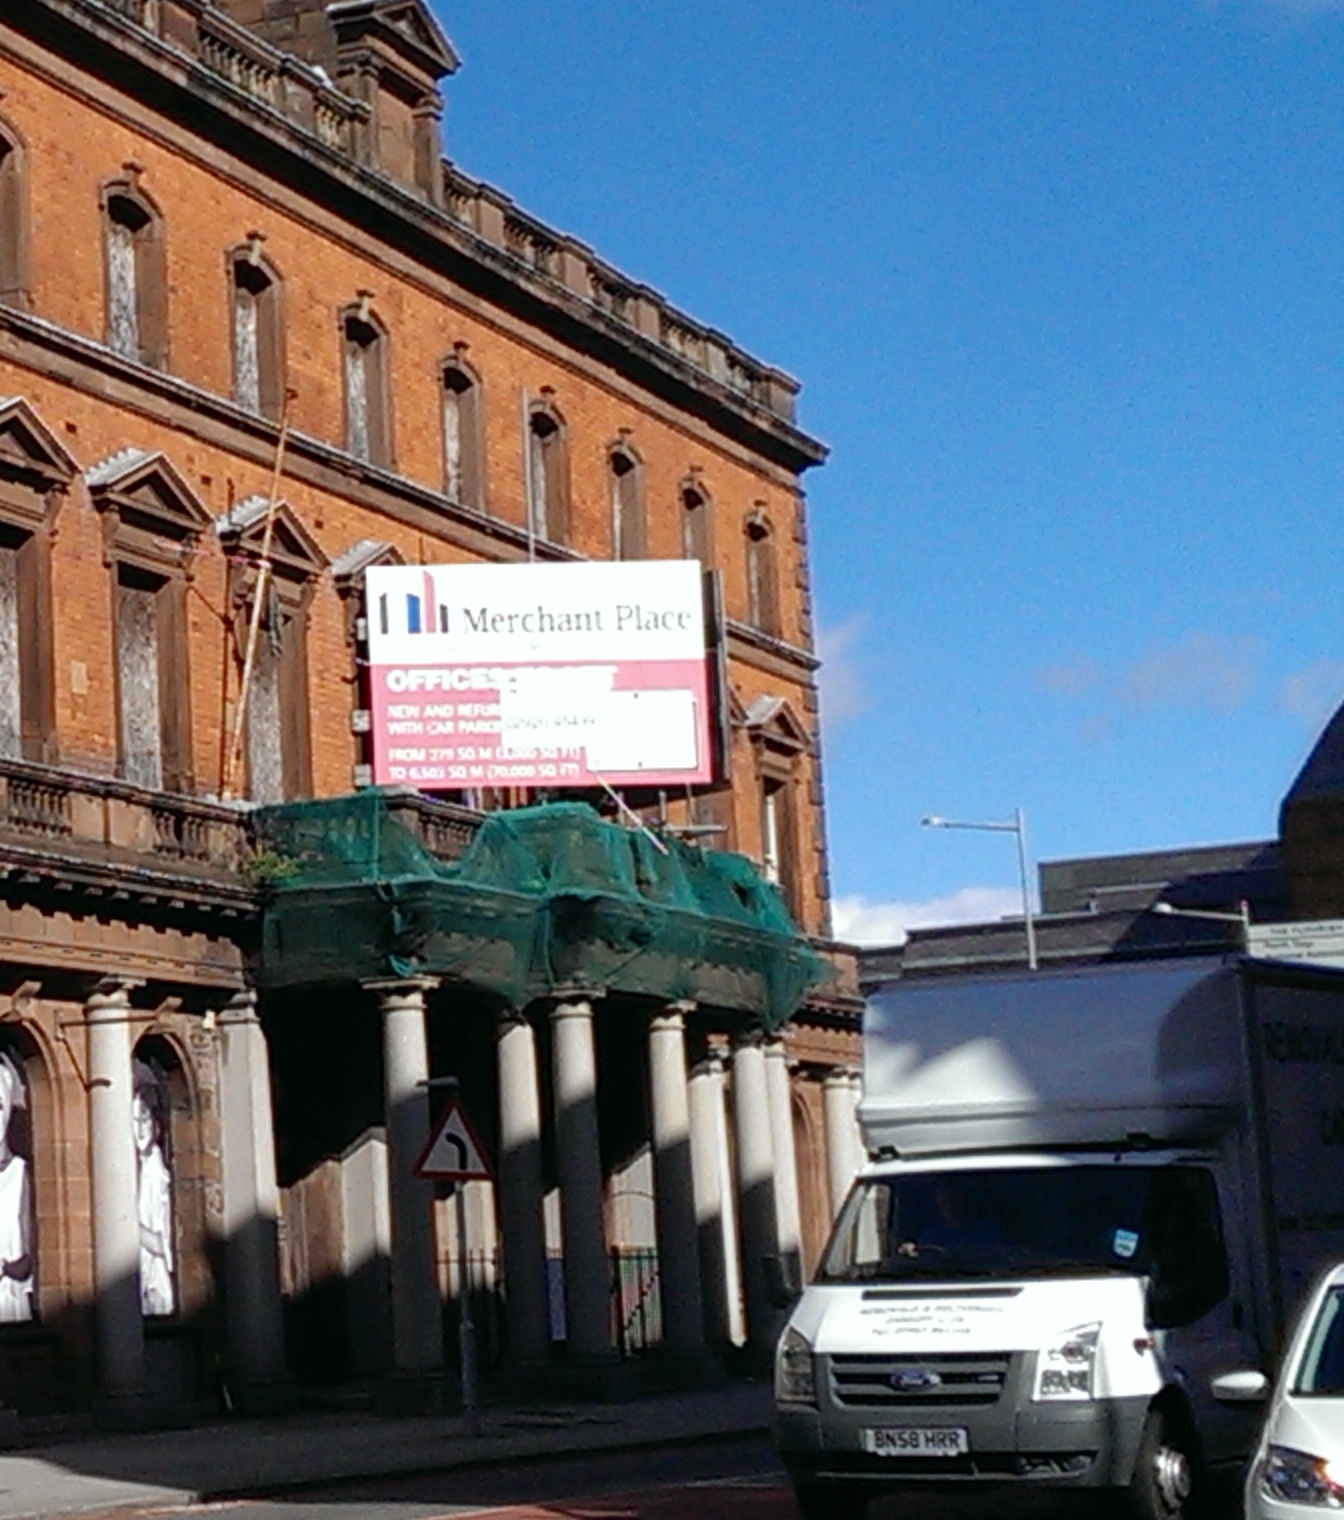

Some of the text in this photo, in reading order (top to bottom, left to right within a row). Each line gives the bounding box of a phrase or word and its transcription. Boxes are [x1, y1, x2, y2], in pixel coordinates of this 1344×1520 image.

[463, 603, 692, 634] Merchant Place
[387, 704, 420, 718] NEW
[423, 703, 454, 718] AND
[387, 721, 424, 735] WITH
[427, 720, 455, 735] CAR
[388, 747, 426, 762] FROM
[457, 747, 476, 761] SQ
[479, 747, 493, 760] M
[389, 767, 406, 780] TO
[448, 766, 467, 780] SQ
[470, 765, 485, 778] M
[538, 763, 557, 778] SQ
[874, 1431, 962, 1449] BN58 HRR
